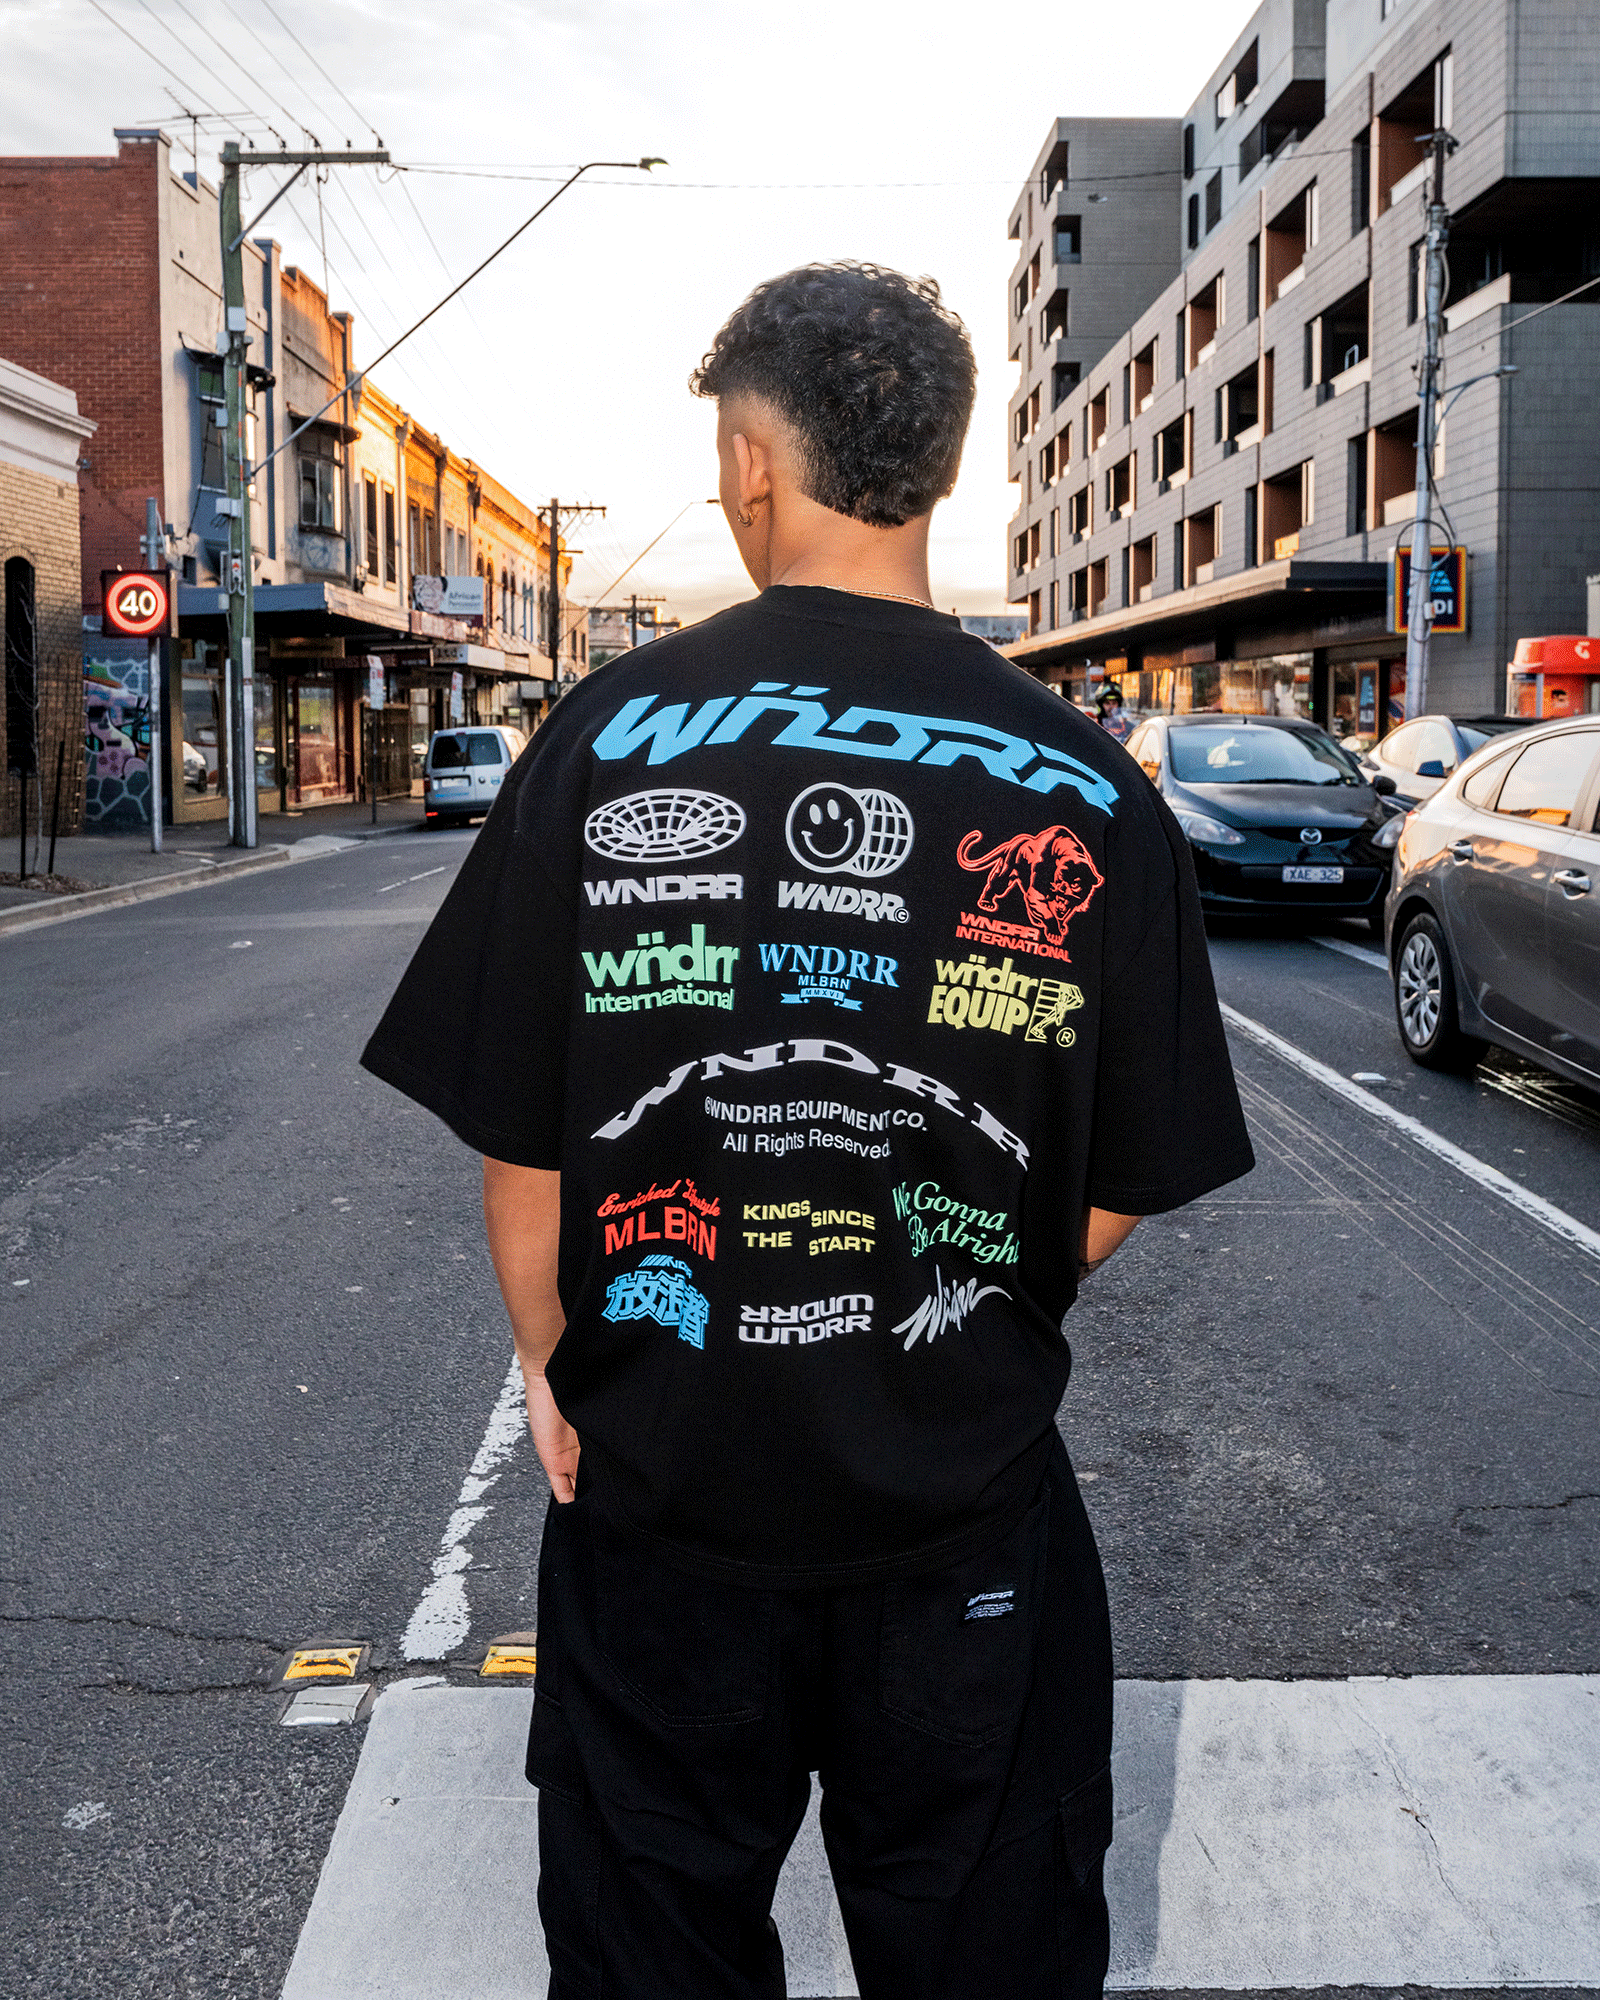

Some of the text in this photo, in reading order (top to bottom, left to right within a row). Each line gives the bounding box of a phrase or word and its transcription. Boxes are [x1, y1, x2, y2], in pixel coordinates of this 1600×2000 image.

[119, 589, 157, 617] 40
[583, 873, 745, 907] WNDRR
[1289, 869, 1342, 881] XAE 325
[960, 911, 1041, 942] WNDRR
[955, 925, 1073, 964] INTERNATIONAL
[758, 943, 901, 988] WNDRR
[585, 982, 735, 1013] International
[797, 974, 851, 990] MLBRN
[804, 989, 841, 999] MMXVI
[926, 984, 1030, 1036] EQUIP
[591, 1038, 1030, 1171] WNDRR
[786, 1100, 892, 1132] EQUIPMENT
[892, 1108, 928, 1132] CO.
[722, 1128, 892, 1160] All Rights Reserved.
[597, 1179, 683, 1218] Enriched
[892, 1181, 1008, 1232] We Gonna
[743, 1200, 876, 1230] KINGS SINCE
[604, 1206, 717, 1262] MLBRN
[742, 1231, 876, 1257] THE START
[928, 1218, 1020, 1265] Alright
[739, 1294, 874, 1324] WNDRR
[738, 1314, 872, 1345] WNDRR
